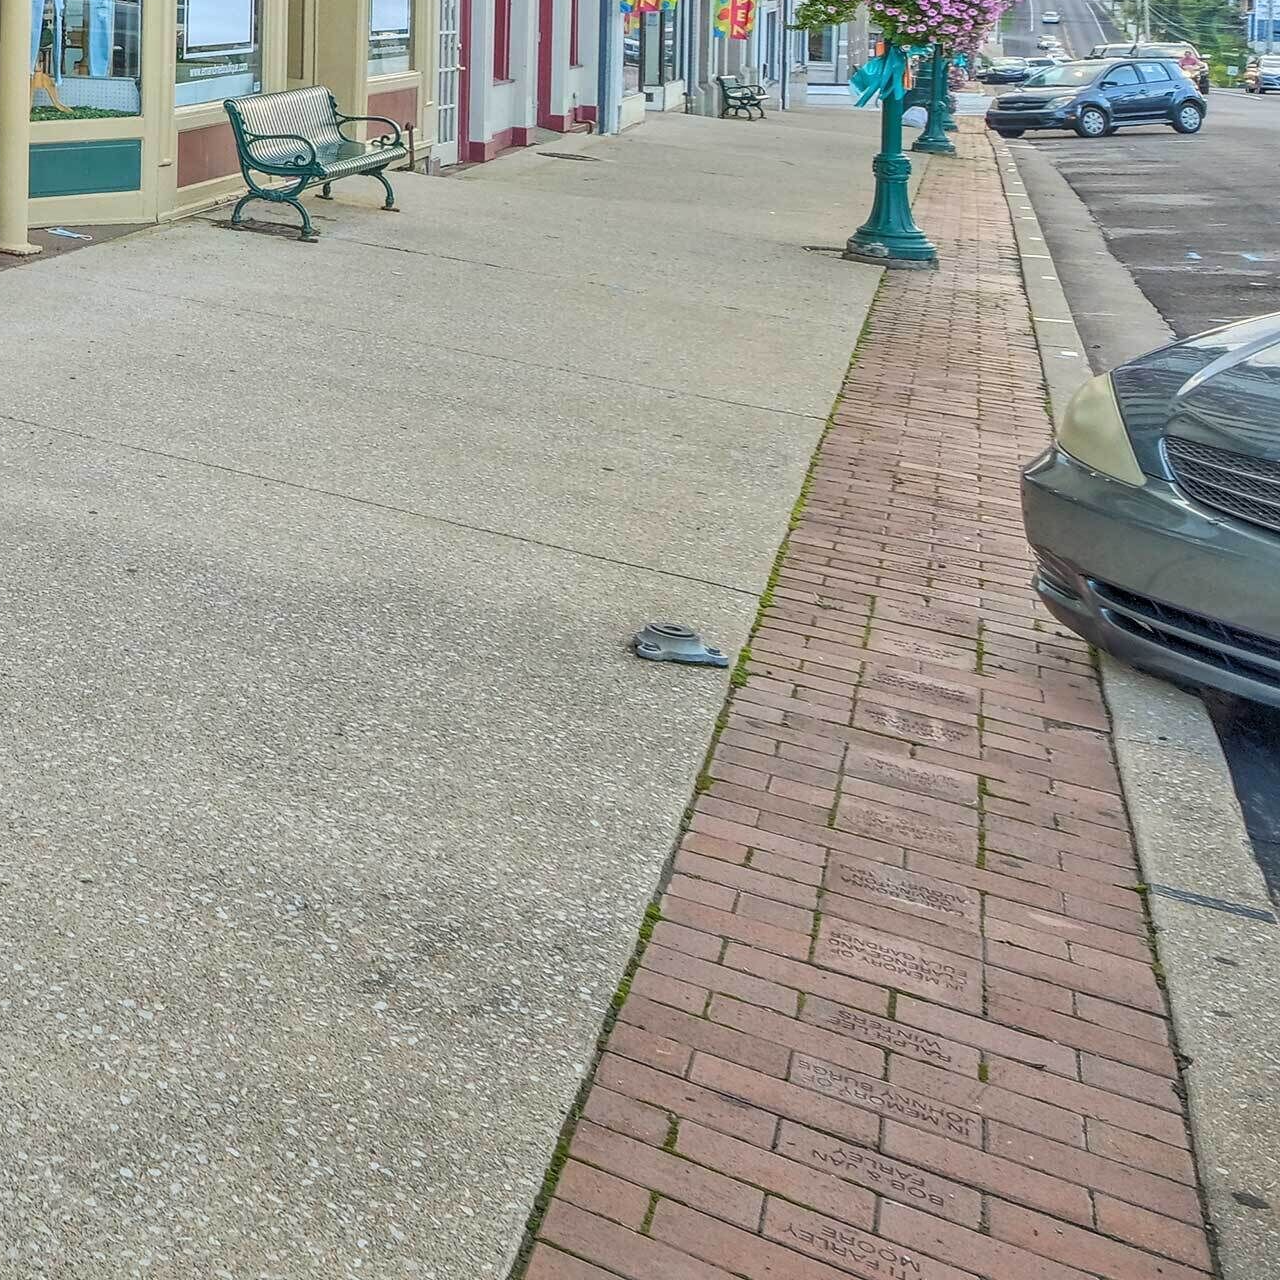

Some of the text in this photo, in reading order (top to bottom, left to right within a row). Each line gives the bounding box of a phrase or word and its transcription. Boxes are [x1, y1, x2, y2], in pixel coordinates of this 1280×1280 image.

[825, 1016, 952, 1063] RALPH LEE
[836, 1009, 942, 1050] WINTERS
[798, 1060, 975, 1124] JOHNNY BURGE
[800, 1073, 969, 1136] IN MEMORY OF
[812, 1149, 858, 1170] JAN
[833, 1148, 925, 1187] FARLEY
[890, 1180, 944, 1207] BOB
[784, 1223, 880, 1270] FARLEY
[821, 1225, 920, 1272] MOORE
